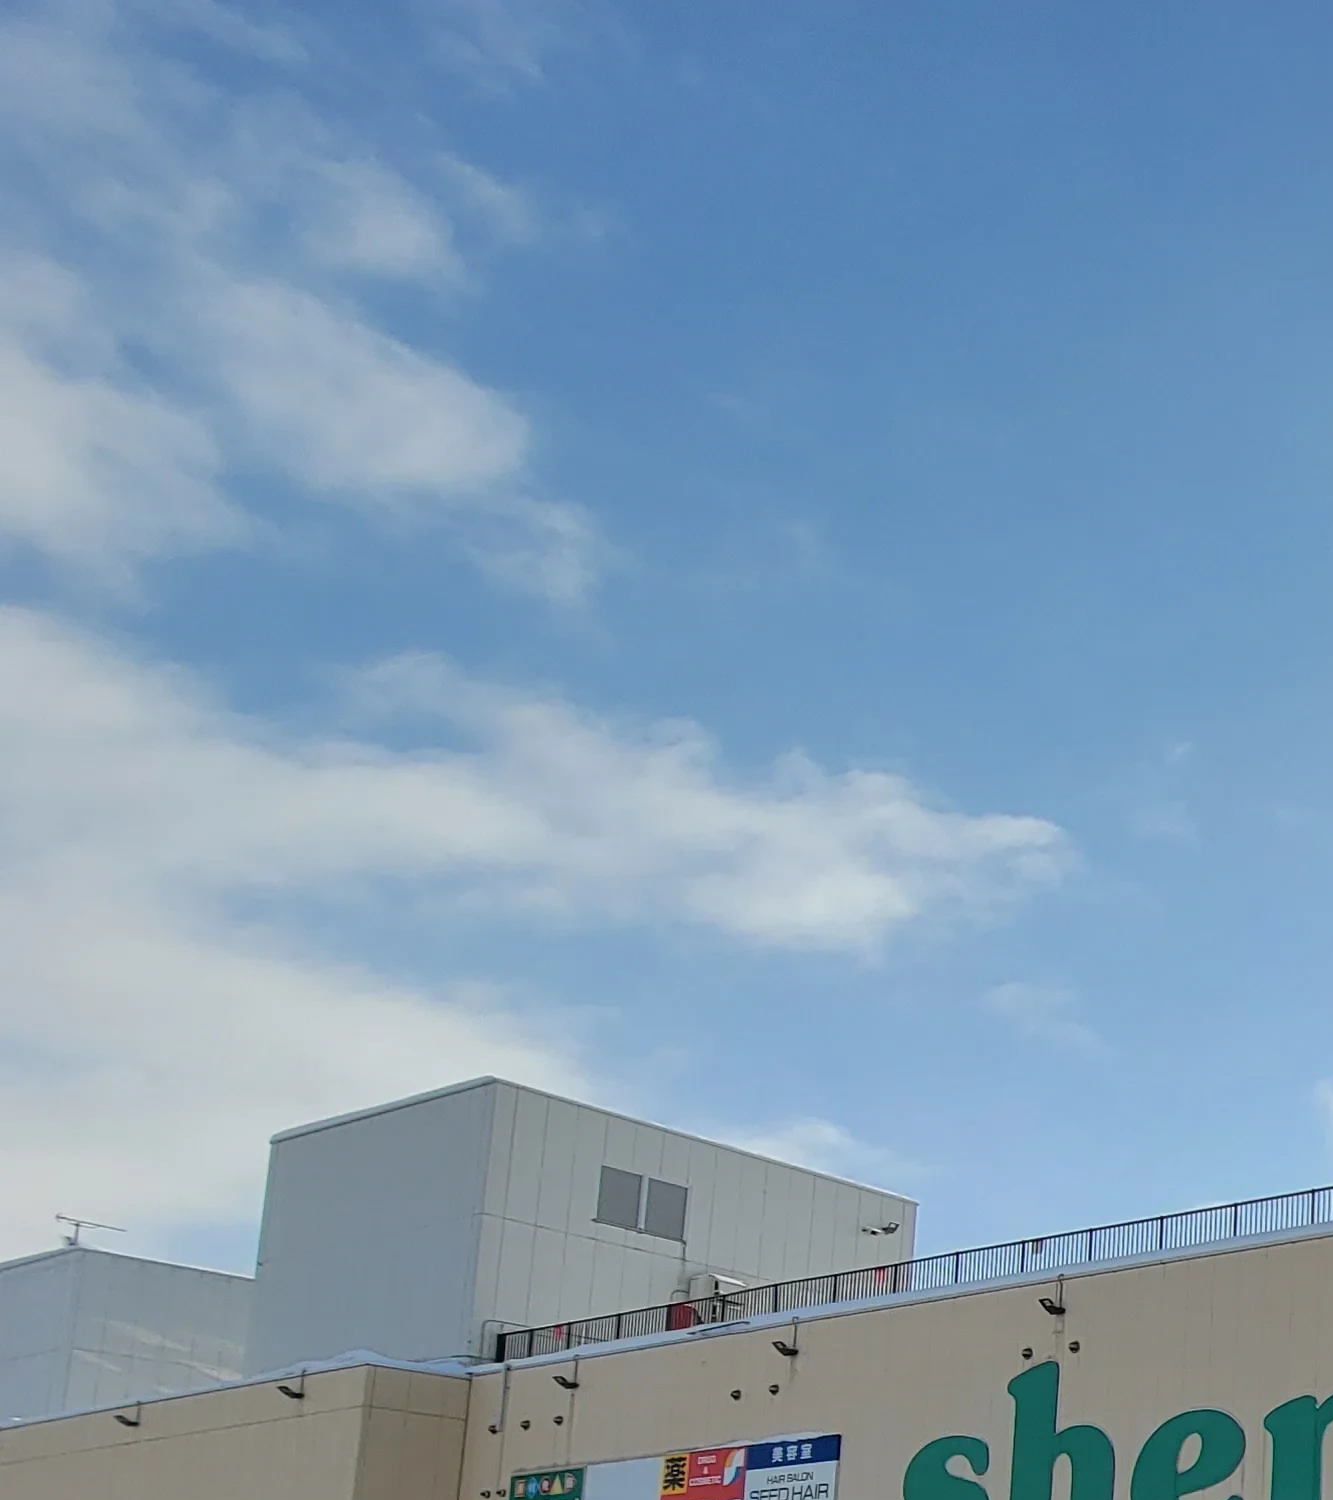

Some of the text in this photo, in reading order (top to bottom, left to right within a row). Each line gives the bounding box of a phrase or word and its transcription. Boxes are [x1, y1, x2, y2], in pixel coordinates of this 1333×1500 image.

[772, 1443, 812, 1464] 美容室
[663, 1457, 687, 1491] 薬
[766, 1471, 814, 1484] HAIR SALON
[793, 1483, 829, 1500] HAIR
